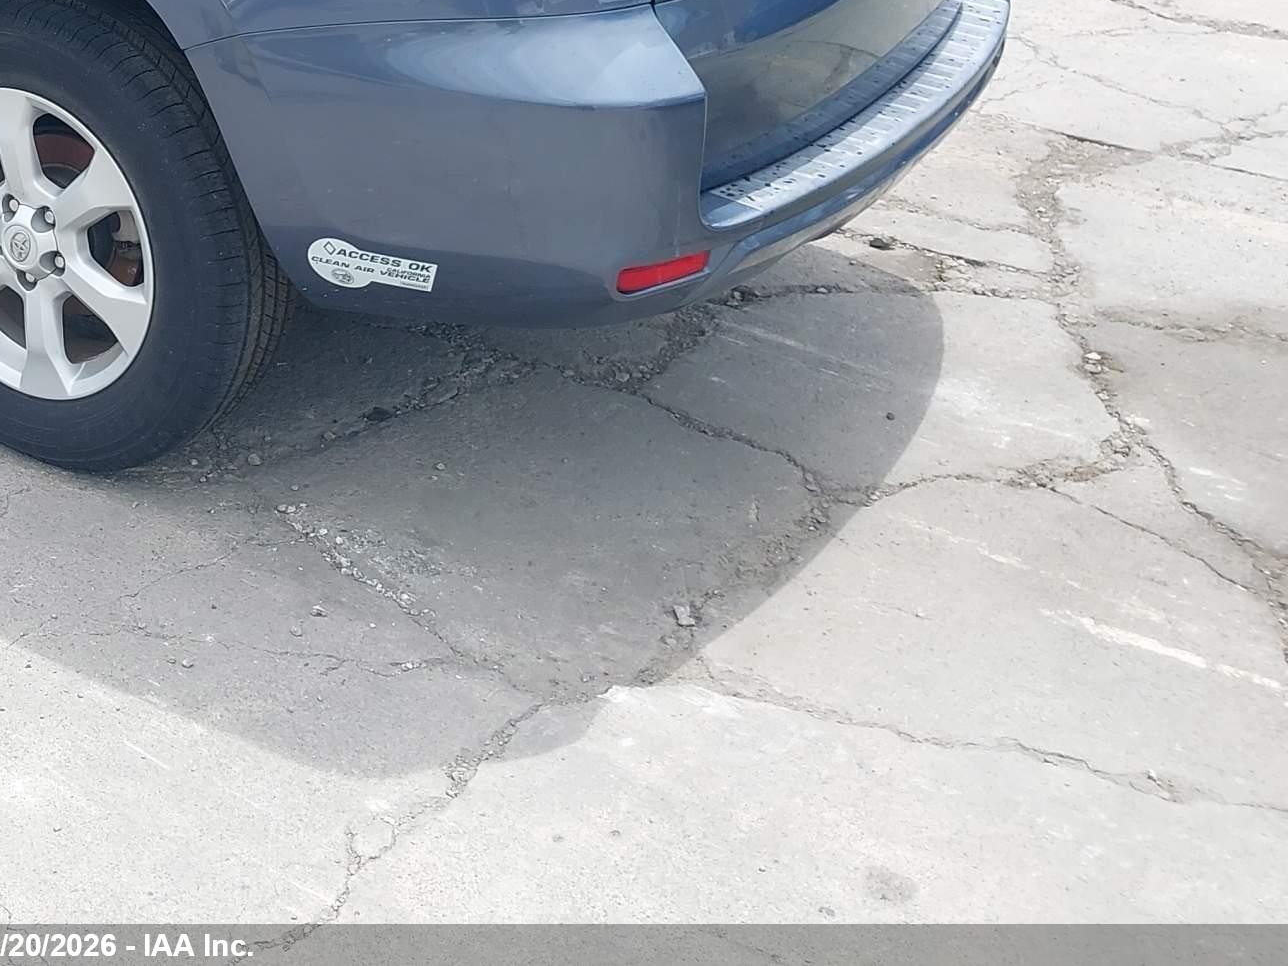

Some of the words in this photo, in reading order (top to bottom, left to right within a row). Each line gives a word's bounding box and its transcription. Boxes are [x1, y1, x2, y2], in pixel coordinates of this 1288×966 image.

[311, 255, 351, 268] CLEAN
[354, 265, 375, 273] AIR
[379, 270, 431, 283] VEHICLE
[336, 248, 402, 268] ACCESS
[408, 262, 432, 273] OK
[386, 267, 431, 278] CALIFORNIA
